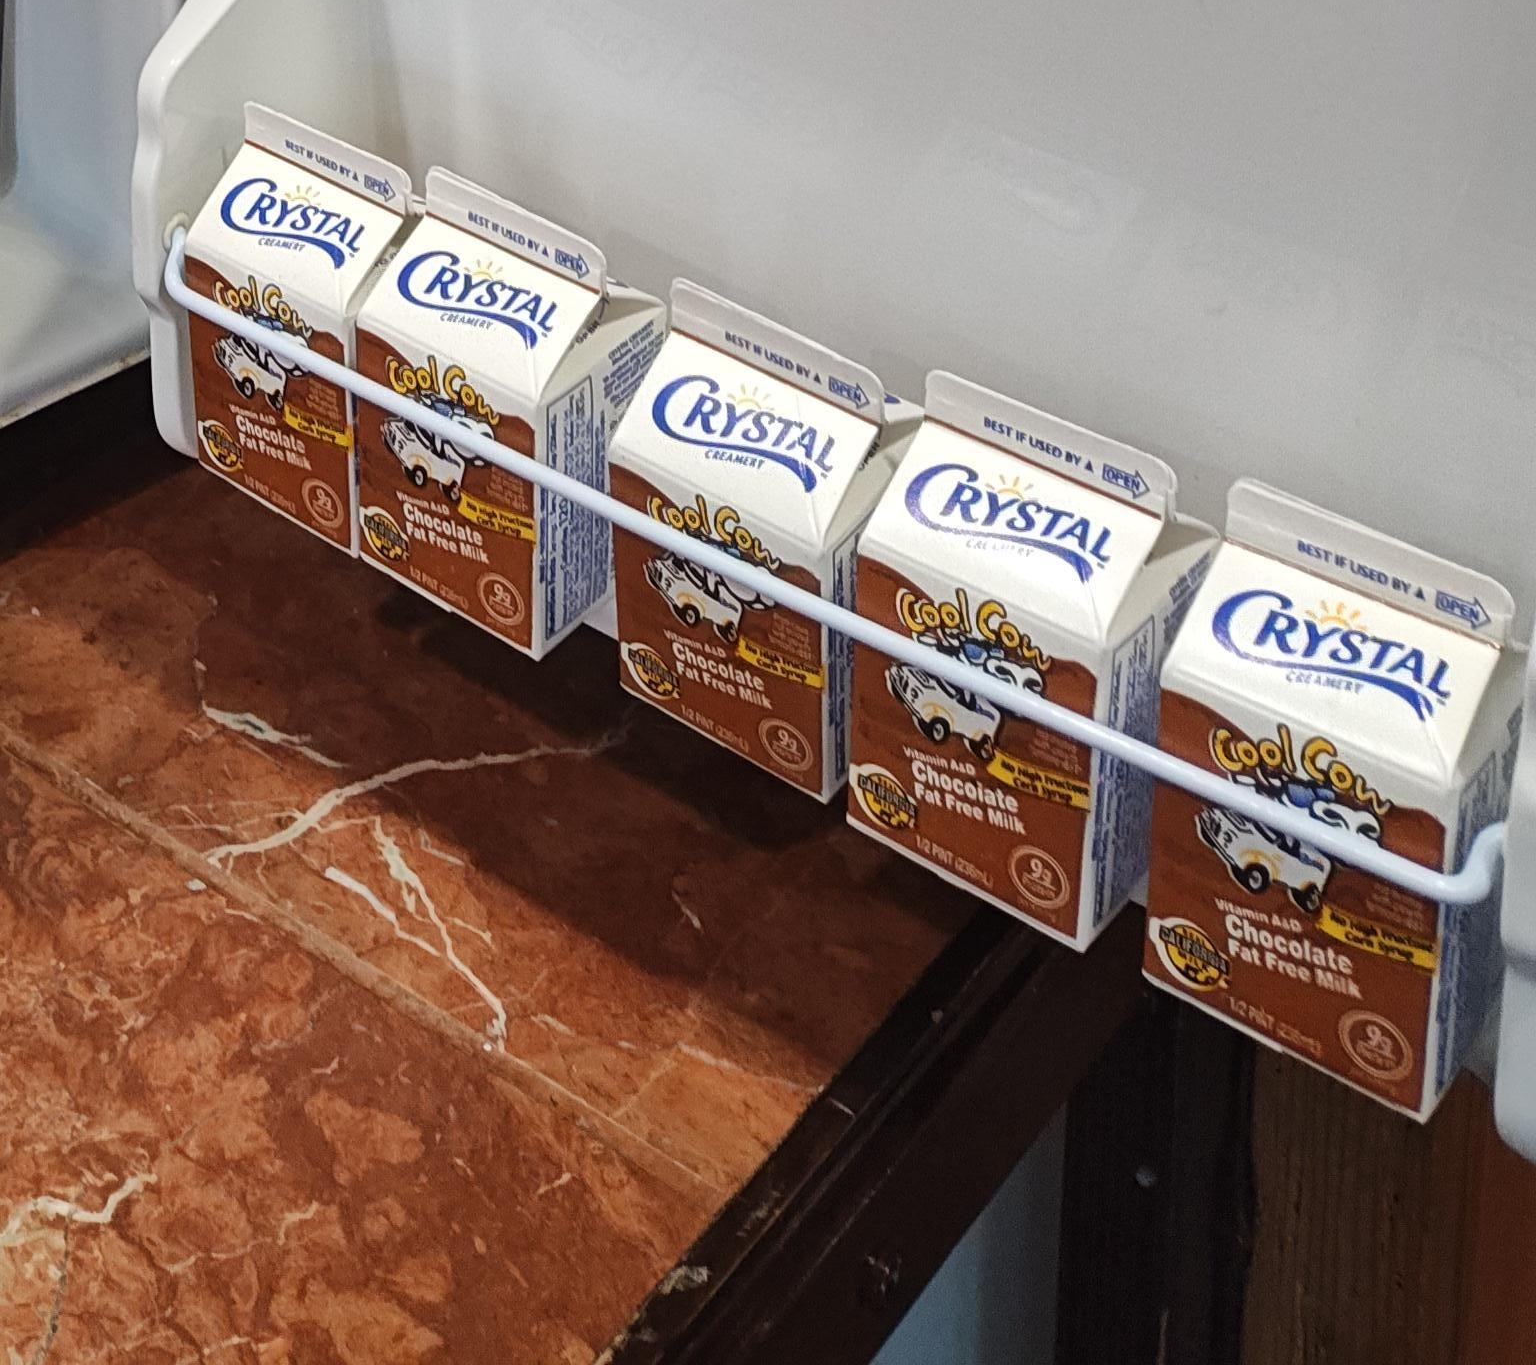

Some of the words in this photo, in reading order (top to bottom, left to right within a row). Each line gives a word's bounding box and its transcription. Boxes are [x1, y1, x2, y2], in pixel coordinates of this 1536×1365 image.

[284, 139, 305, 157] BEST
[306, 150, 315, 159] IF
[315, 151, 338, 172] USED
[339, 165, 351, 178] BY
[364, 175, 389, 195] OPEN
[220, 178, 365, 270] CRYSTAL
[258, 237, 306, 252] CREAMERY
[397, 250, 558, 351] CRYSTAL
[440, 313, 494, 330] CREAMERY
[235, 414, 306, 453] Chocolate
[239, 433, 258, 452] Fat
[259, 441, 285, 462] Free
[287, 452, 312, 471] Milk
[651, 375, 836, 493] CRYSTAL
[705, 449, 766, 470] CREAMERY
[983, 416, 1014, 438] BEST
[1015, 429, 1027, 444] IF
[1028, 433, 1064, 459] USED
[1065, 449, 1082, 466] BY
[1105, 467, 1141, 492] OPEN
[402, 501, 483, 547] Chocolate
[405, 521, 428, 543] Fat
[429, 532, 459, 555] Free
[460, 542, 490, 565] Milk
[904, 462, 1111, 584] CRYSTAL
[1297, 539, 1332, 564] BEST
[1334, 554, 1347, 569] IF
[1348, 559, 1389, 586] USED
[1391, 575, 1412, 595] BY
[1438, 595, 1480, 622] OPEN
[671, 642, 765, 692] Chocolate
[1211, 589, 1452, 722] CRYSTAL
[674, 661, 701, 685] Fat
[702, 675, 736, 700] Free
[738, 686, 773, 711] Milk
[1285, 670, 1364, 695] CREAMERY
[911, 761, 1019, 814] Chocolate
[914, 782, 944, 808] Fat
[945, 796, 984, 822] Free
[987, 808, 1026, 836] Milk
[1224, 913, 1354, 976] Chocolate
[1226, 937, 1262, 969] Fat
[1264, 954, 1310, 985] Free
[1314, 966, 1363, 999] Milk
